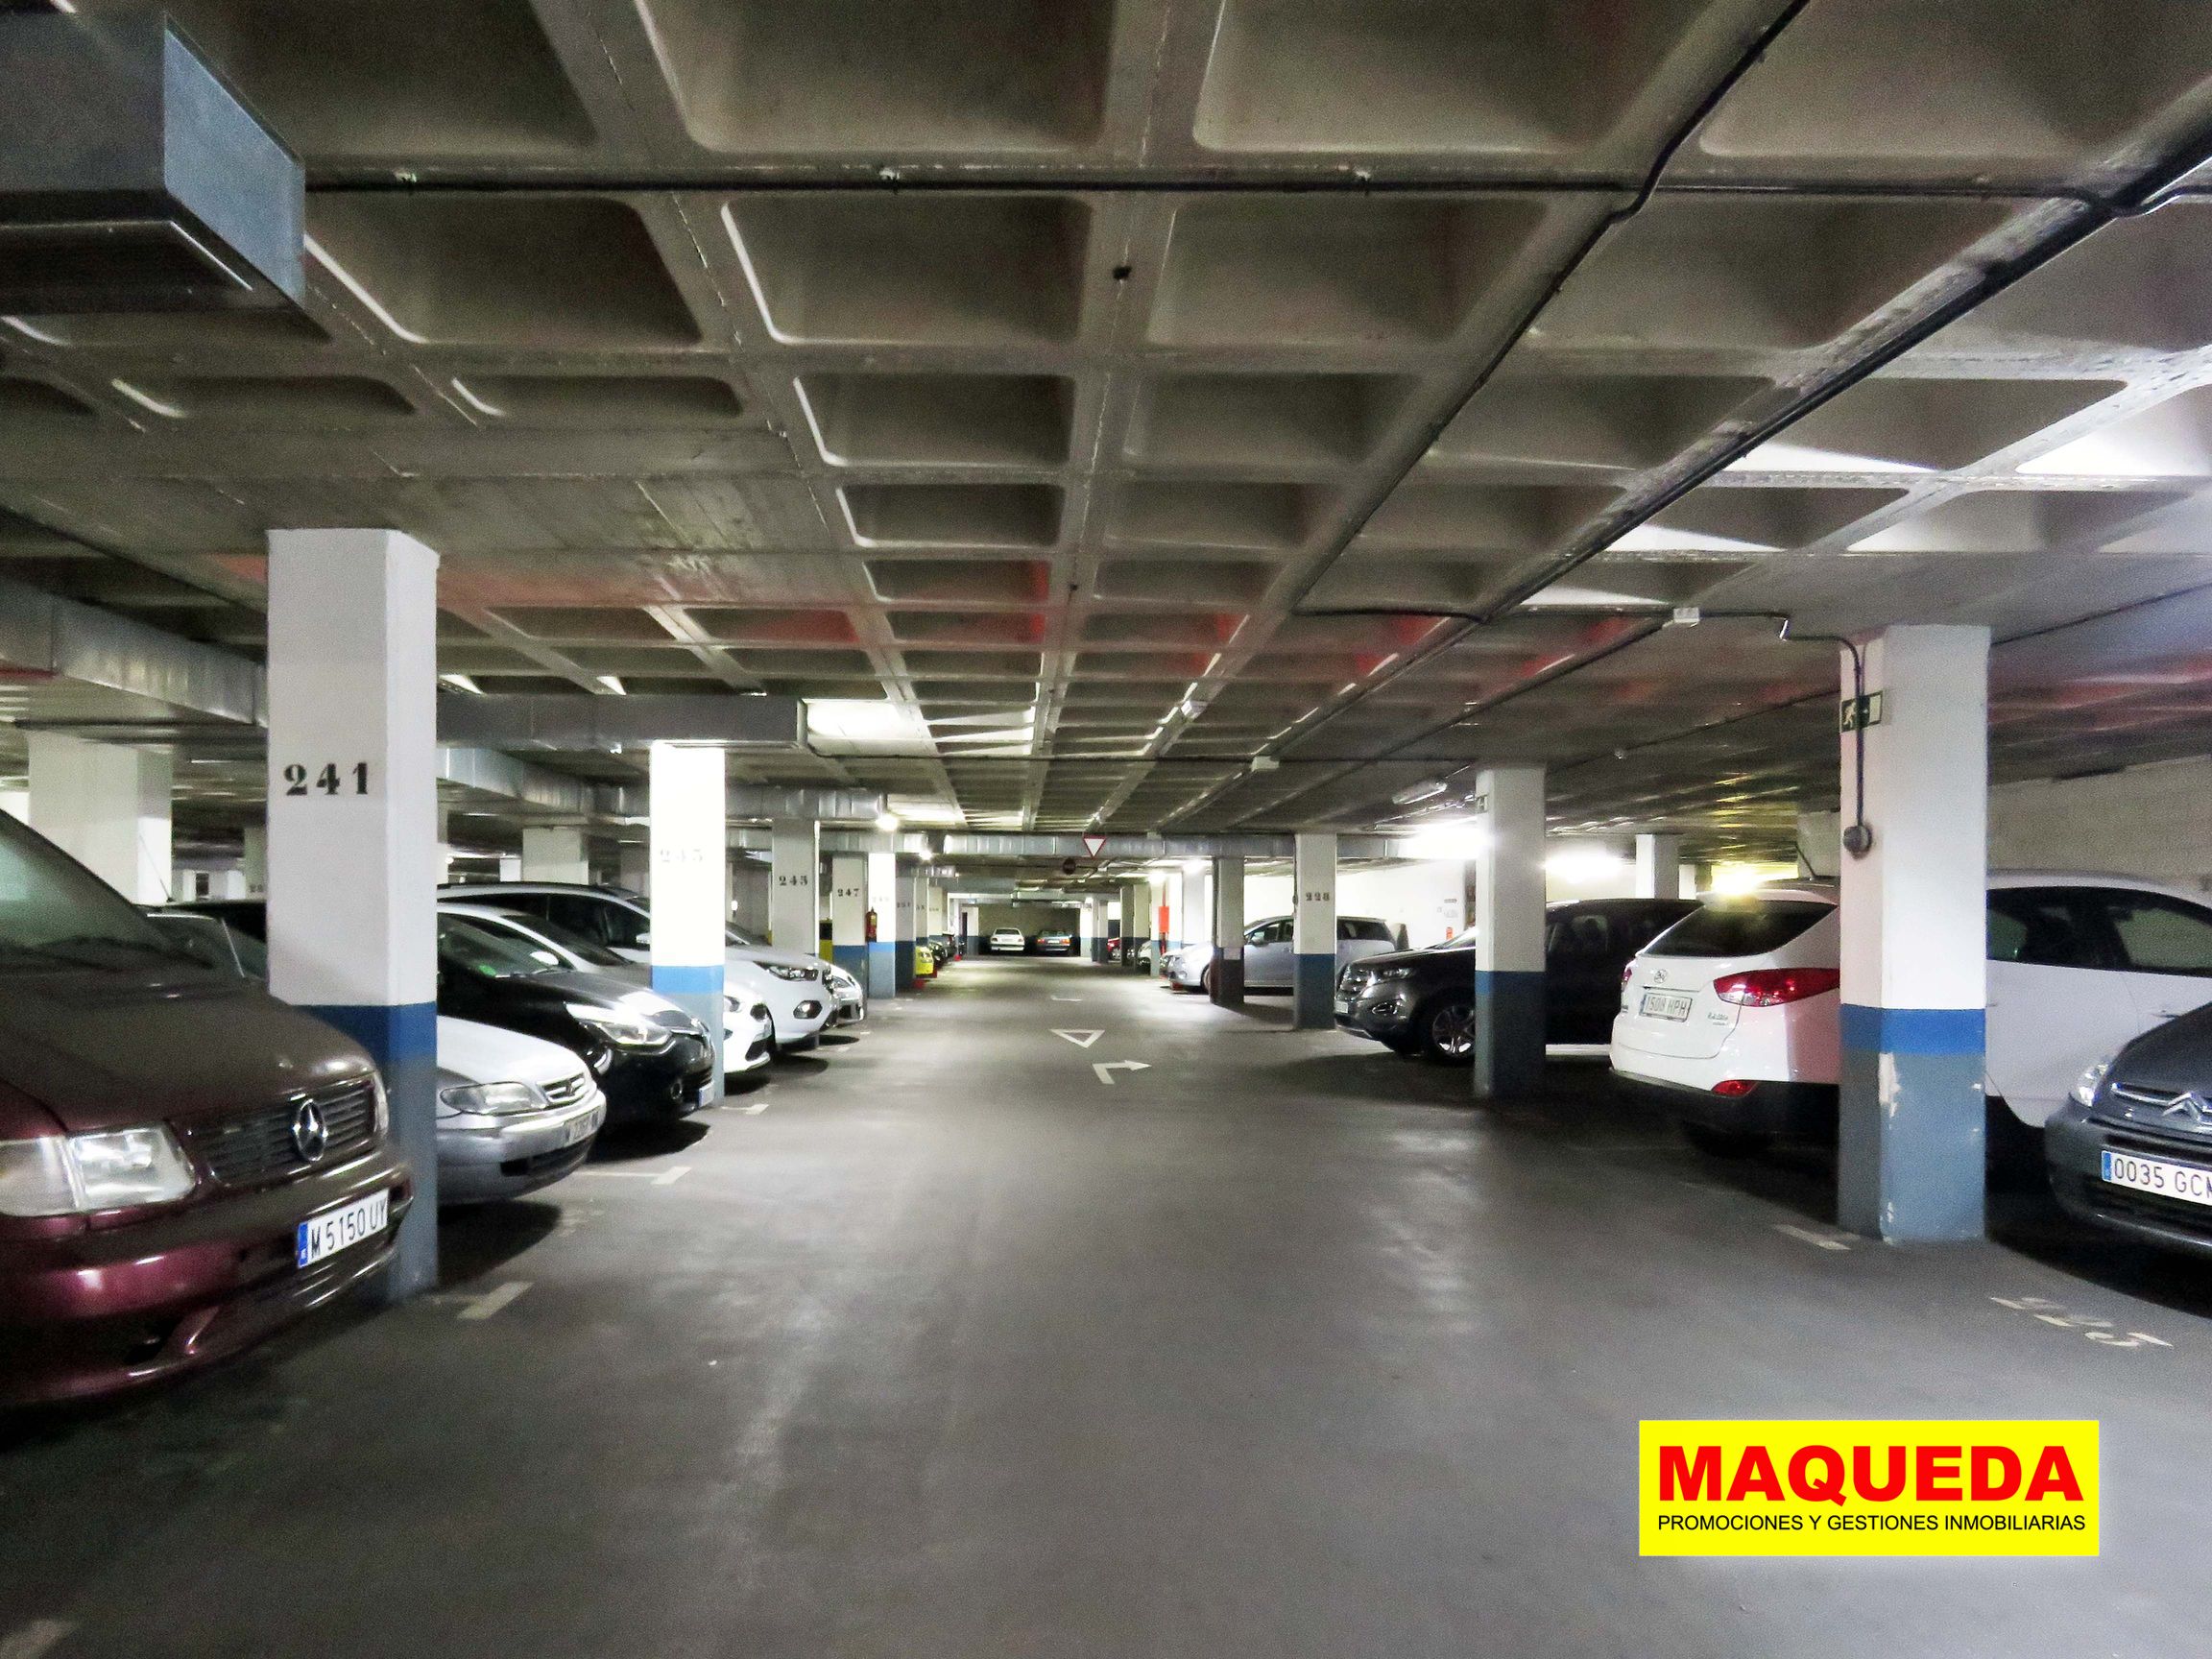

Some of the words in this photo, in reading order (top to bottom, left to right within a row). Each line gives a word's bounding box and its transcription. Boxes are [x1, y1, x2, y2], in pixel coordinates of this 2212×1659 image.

[283, 762, 368, 796] 241
[2114, 1158, 2165, 1189] 0035
[311, 1225, 321, 1260] M
[326, 1208, 366, 1251] 5150
